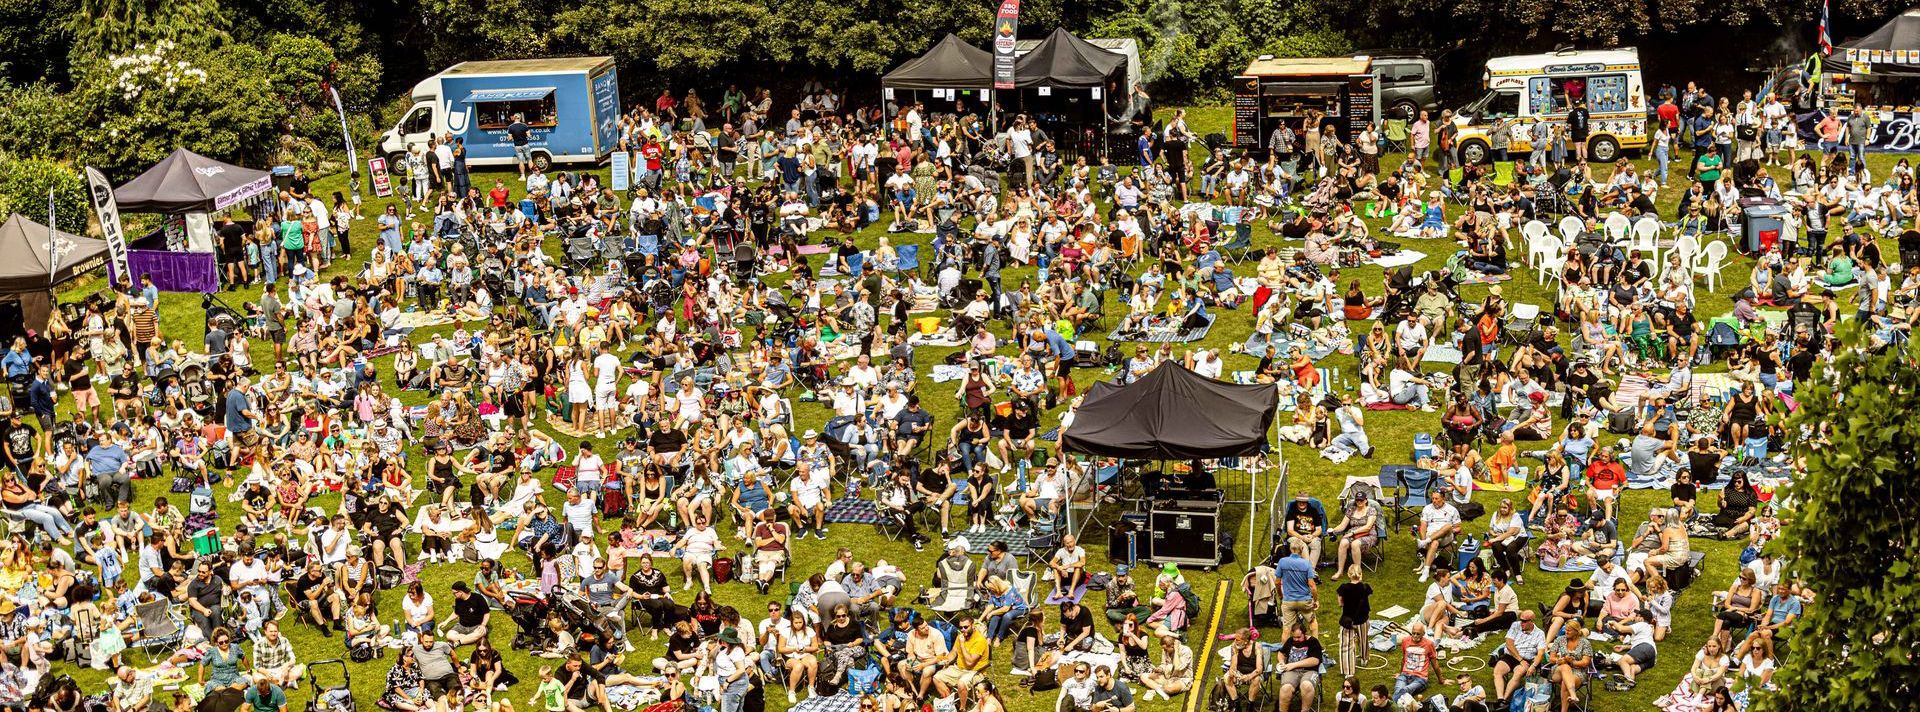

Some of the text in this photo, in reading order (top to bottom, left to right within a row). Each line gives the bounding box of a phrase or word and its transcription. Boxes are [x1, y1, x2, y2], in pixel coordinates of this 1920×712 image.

[1496, 78, 1524, 87] CANDY FLOSS
[72, 256, 104, 275] Brownies
[102, 554, 115, 568] 13
